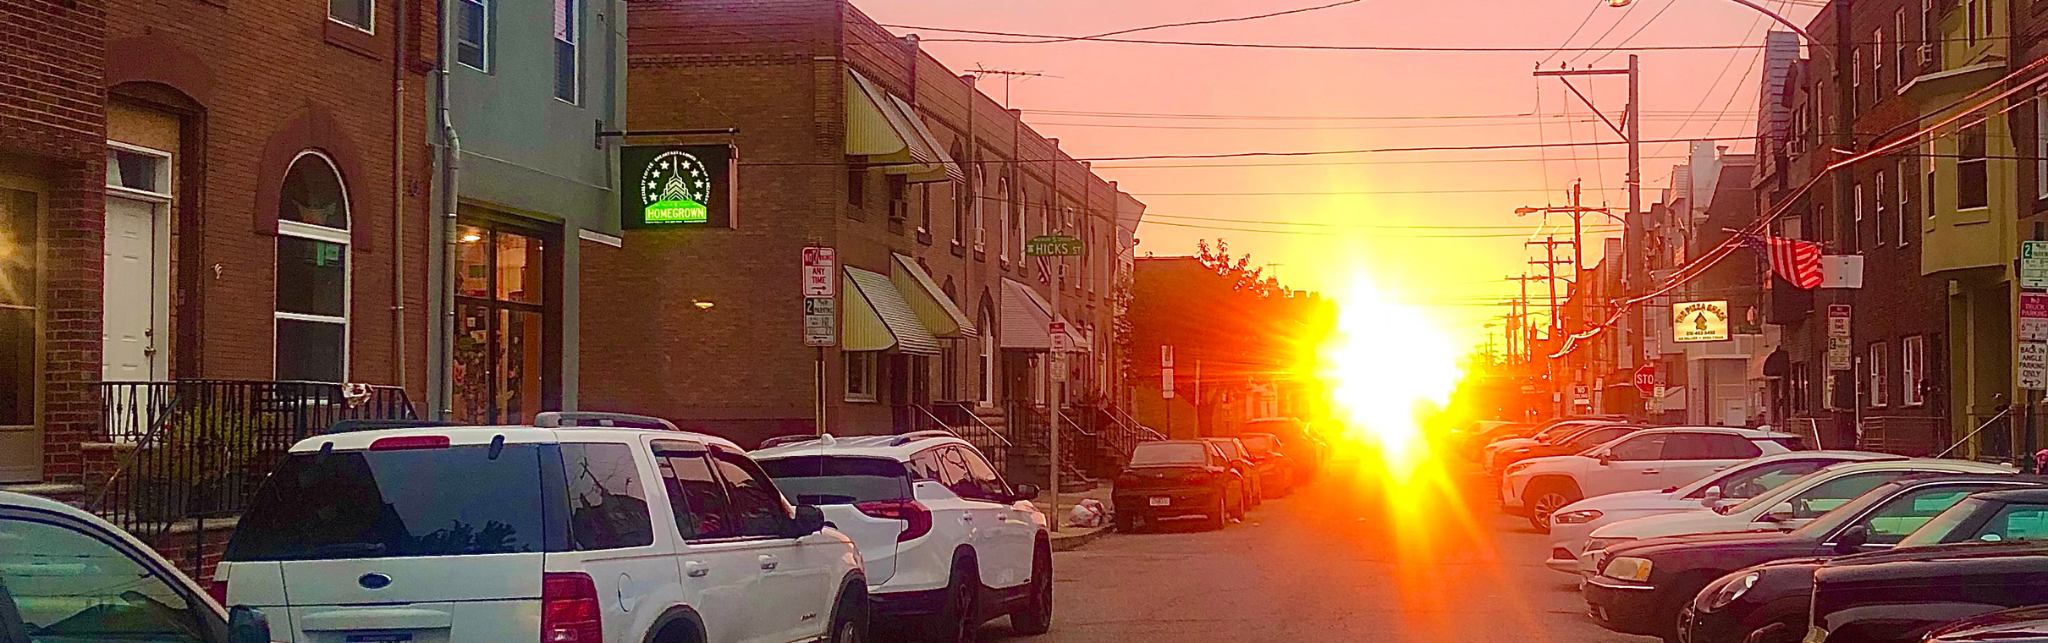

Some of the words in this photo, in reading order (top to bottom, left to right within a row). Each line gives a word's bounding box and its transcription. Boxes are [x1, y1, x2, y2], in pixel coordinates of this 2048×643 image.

[647, 208, 704, 219] HOMEGROWN
[1035, 243, 1069, 255] HICKS
[1072, 246, 1082, 255] ST
[2025, 245, 2031, 257] 2
[812, 276, 826, 284] TIME
[807, 301, 812, 312] 2
[1675, 310, 1688, 324] THE
[1684, 303, 1706, 315] PIZZA
[1706, 303, 1727, 322] SHACK
[2020, 346, 2036, 354] BACK
[2019, 361, 2046, 370] PARKING
[2022, 369, 2041, 378] ONLY
[1636, 374, 1654, 384] STO
